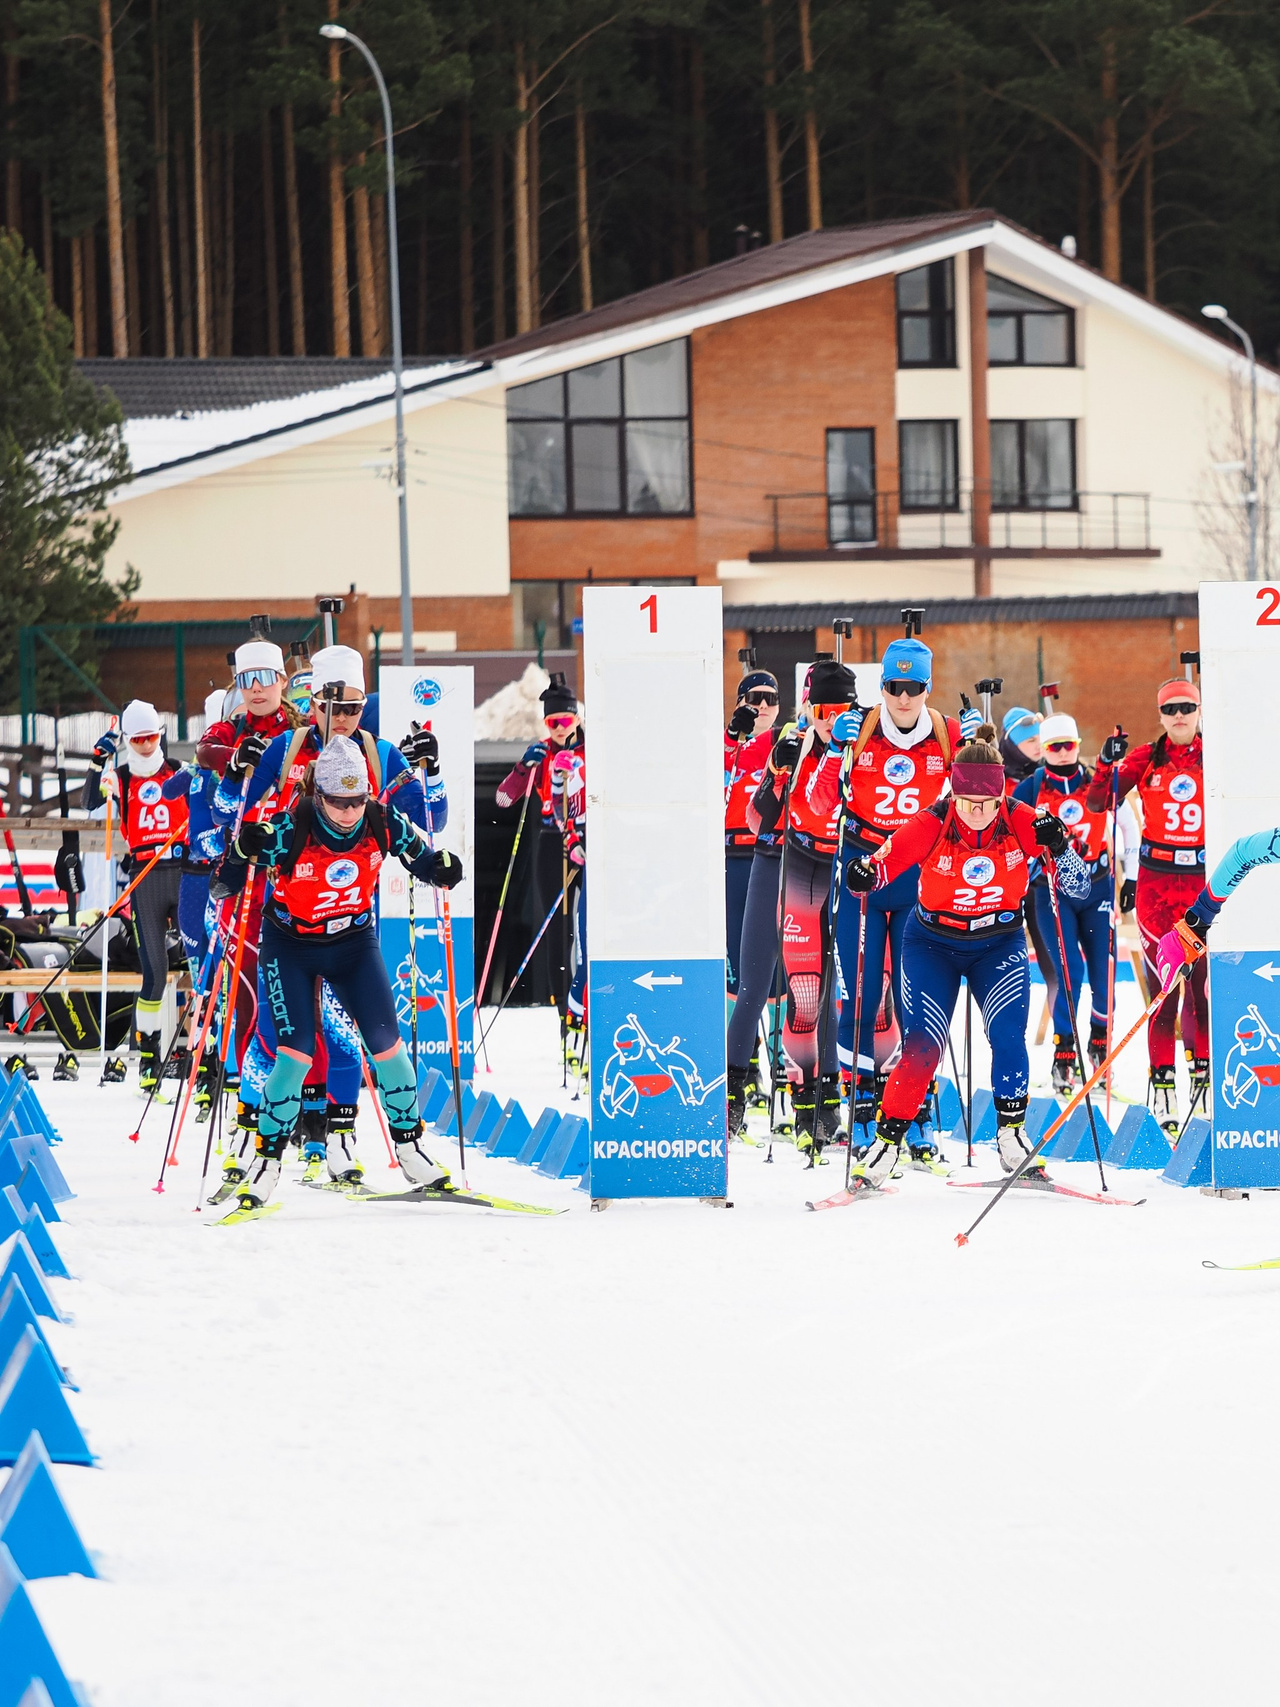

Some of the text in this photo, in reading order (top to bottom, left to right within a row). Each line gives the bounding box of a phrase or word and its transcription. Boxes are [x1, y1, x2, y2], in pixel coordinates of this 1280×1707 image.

[640, 594, 658, 633] 1
[1256, 587, 1280, 625] 2
[875, 786, 920, 815] 26
[138, 804, 170, 831] 49
[1163, 802, 1202, 832] 39
[313, 886, 362, 910] 21
[953, 886, 1004, 906] 22
[339, 1107, 353, 1115] 175
[403, 1131, 416, 1139] 171
[593, 1139, 724, 1159] КРАСНОЯРСК
